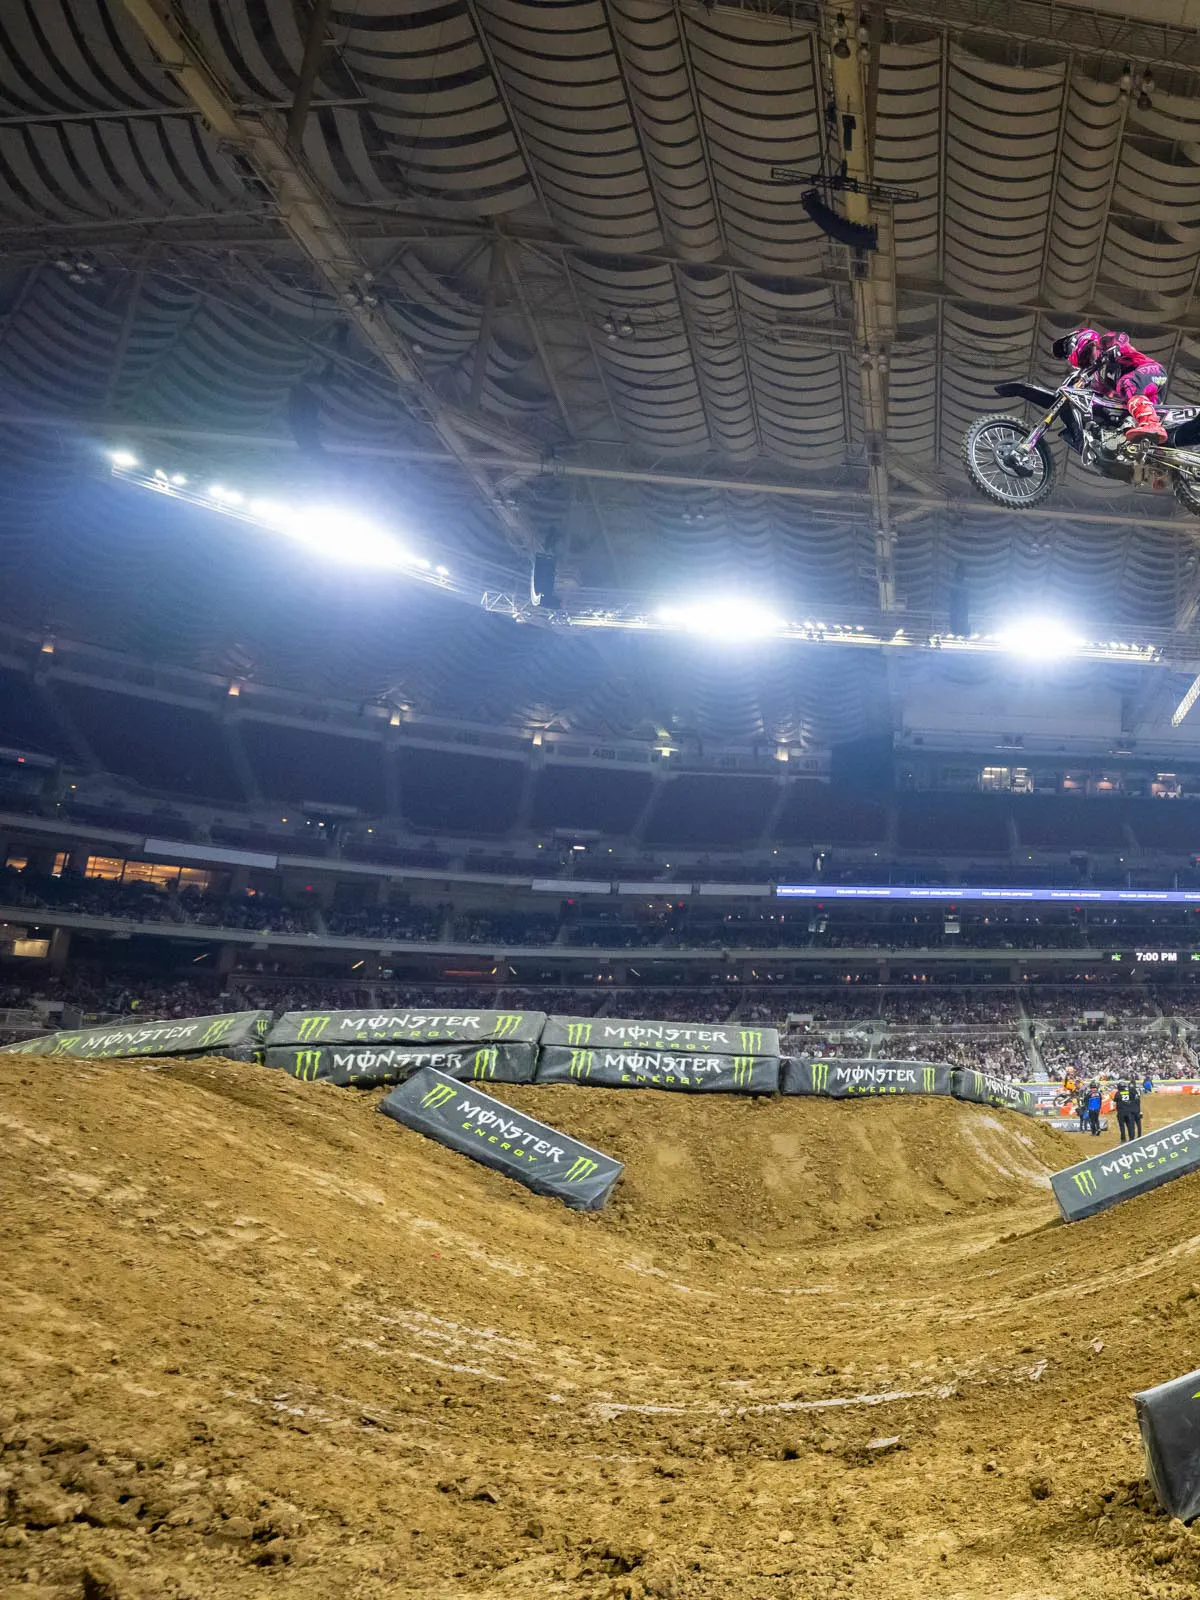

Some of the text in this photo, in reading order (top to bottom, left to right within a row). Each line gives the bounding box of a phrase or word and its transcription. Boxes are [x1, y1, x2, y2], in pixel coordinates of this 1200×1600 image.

[1136, 952, 1178, 961] 7:00 PM
[340, 1014, 480, 1030] MONSTER
[80, 1025, 199, 1050] MONSTER
[355, 1030, 456, 1039] ENERGY
[604, 1024, 730, 1044] MONSTER
[622, 1040, 711, 1051] ENERGY
[333, 1050, 462, 1072] MONSTER
[604, 1052, 722, 1074] MONSTER
[621, 1073, 705, 1085] ENERGY
[836, 1065, 917, 1084] MONSTER
[848, 1085, 906, 1094] ENERGY
[984, 1076, 1021, 1104] MONSTER
[456, 1100, 566, 1163] MONSTER
[461, 1122, 538, 1163] ENERGY
[1101, 1127, 1200, 1177] MONSTER
[1122, 1146, 1190, 1181] ENERGY
